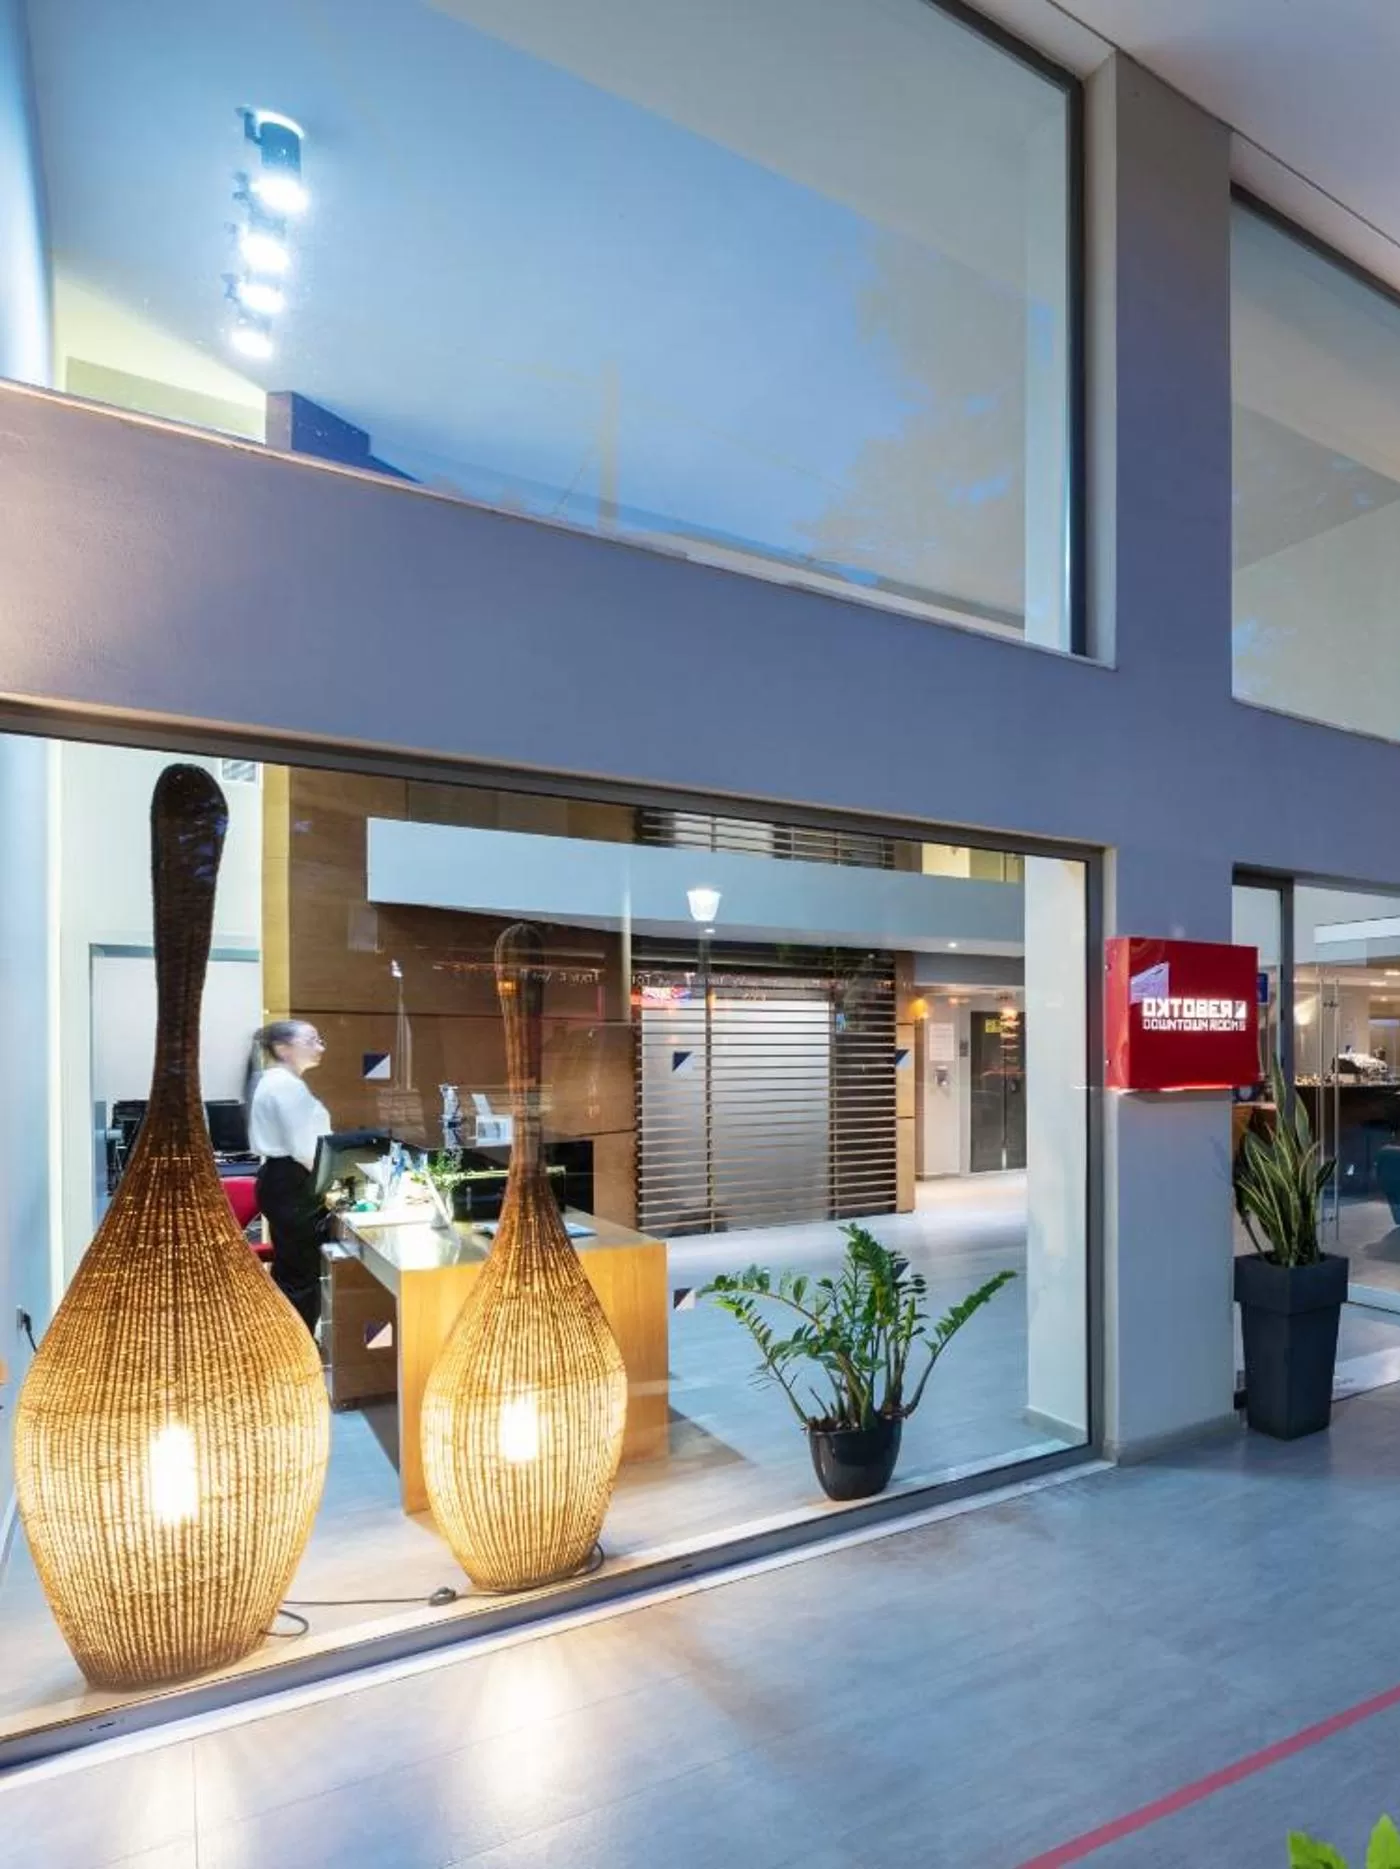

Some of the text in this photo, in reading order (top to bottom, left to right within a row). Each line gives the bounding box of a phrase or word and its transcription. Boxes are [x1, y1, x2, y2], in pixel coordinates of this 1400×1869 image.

[1142, 998, 1233, 1018] OKTOBER
[1142, 1018, 1246, 1031] DOWNTOWN ROOMS
